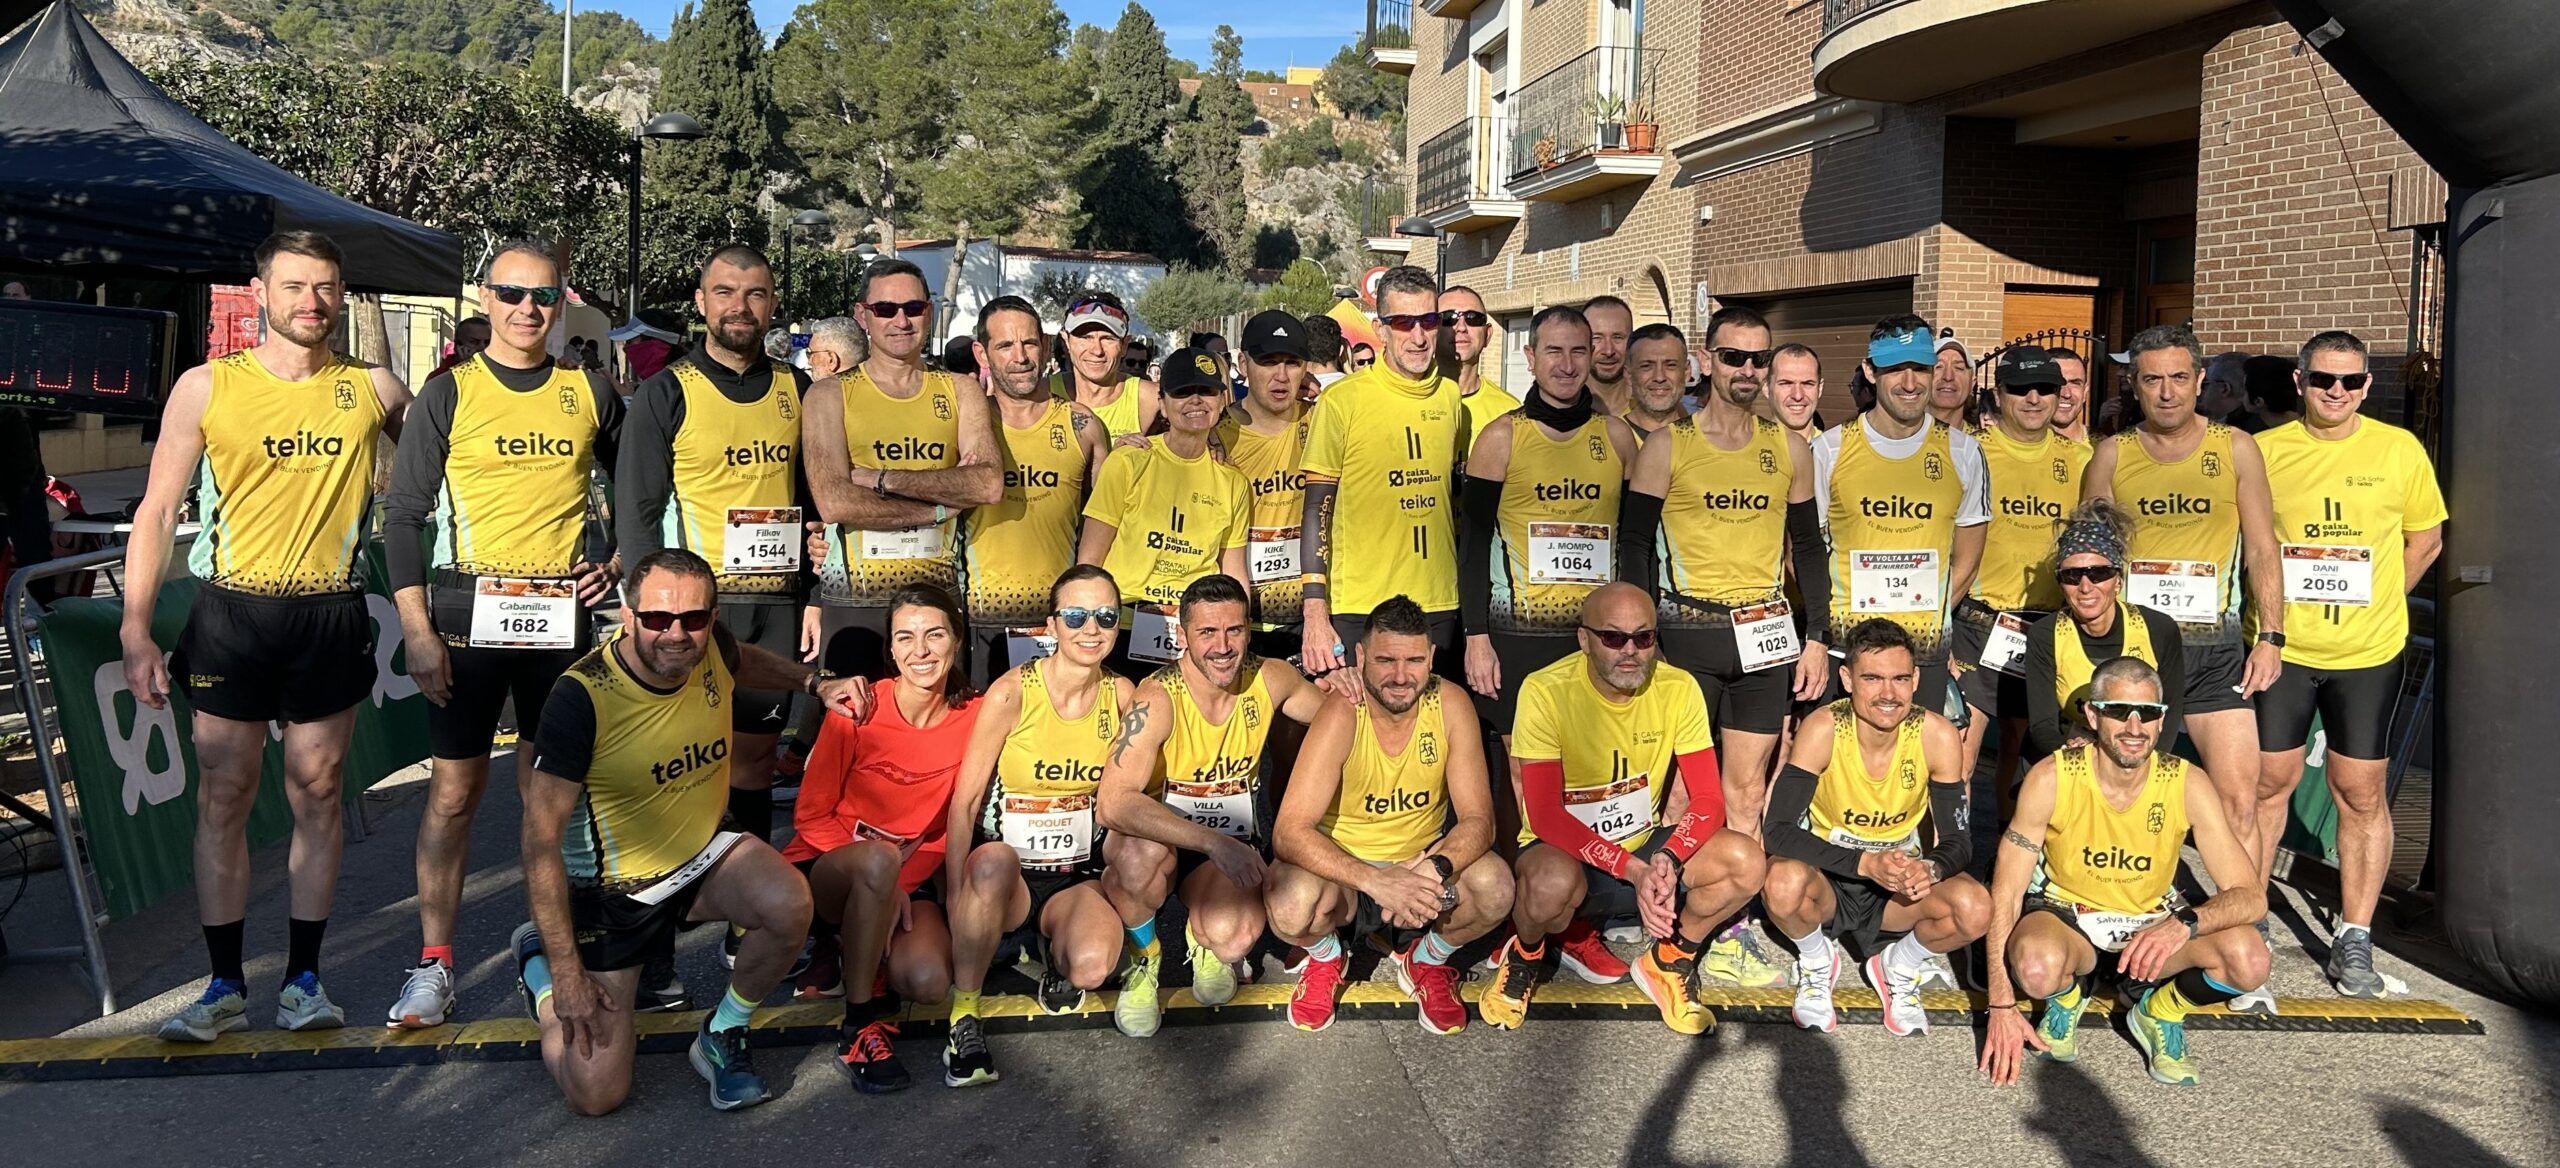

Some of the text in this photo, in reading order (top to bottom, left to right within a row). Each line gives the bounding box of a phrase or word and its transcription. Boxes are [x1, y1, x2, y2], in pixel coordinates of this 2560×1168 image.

[263, 430, 342, 458] teika
[495, 432, 574, 456] teika
[873, 437, 945, 460] teika
[725, 440, 791, 466] teika
[1004, 464, 1058, 487] eika
[1406, 468, 1430, 476] caixa
[1406, 475, 1441, 485] popular
[1535, 478, 1600, 500] teika
[1400, 494, 1435, 509] teika
[1703, 489, 1769, 510] teika
[2000, 495, 2061, 517] teika
[2137, 493, 2210, 515] teika
[1860, 495, 1932, 519] teika
[756, 529, 781, 537] Filkov
[1876, 524, 1893, 533] BUEN
[1895, 523, 1924, 533] VENDING
[1166, 536, 1189, 546] caixa
[1558, 541, 1594, 551] MOMPÓ
[748, 544, 786, 558] 1544
[1164, 543, 1203, 556] popular
[1265, 546, 1284, 554] KIKE
[1255, 558, 1290, 573] 1293
[1551, 557, 1592, 571] 1064
[2313, 565, 2338, 573] DANI
[1885, 577, 1908, 588] 134
[2159, 579, 2185, 587] DANI
[2303, 578, 2348, 591] 2050
[499, 602, 551, 611] Cabanillas
[2150, 593, 2194, 607] 1317
[500, 618, 548, 632] 1682
[1752, 622, 1785, 634] ALFONSO
[1757, 636, 1788, 654] 1029
[651, 737, 727, 785] teika
[1193, 755, 1252, 782] teika
[1365, 788, 1430, 815] teika
[1600, 802, 1619, 813] AJC
[1028, 817, 1073, 827] POQUET
[1590, 813, 1634, 834] 1042
[1843, 808, 1908, 827] teika
[1027, 834, 1073, 850] 1179
[2083, 846, 2152, 871] teika
